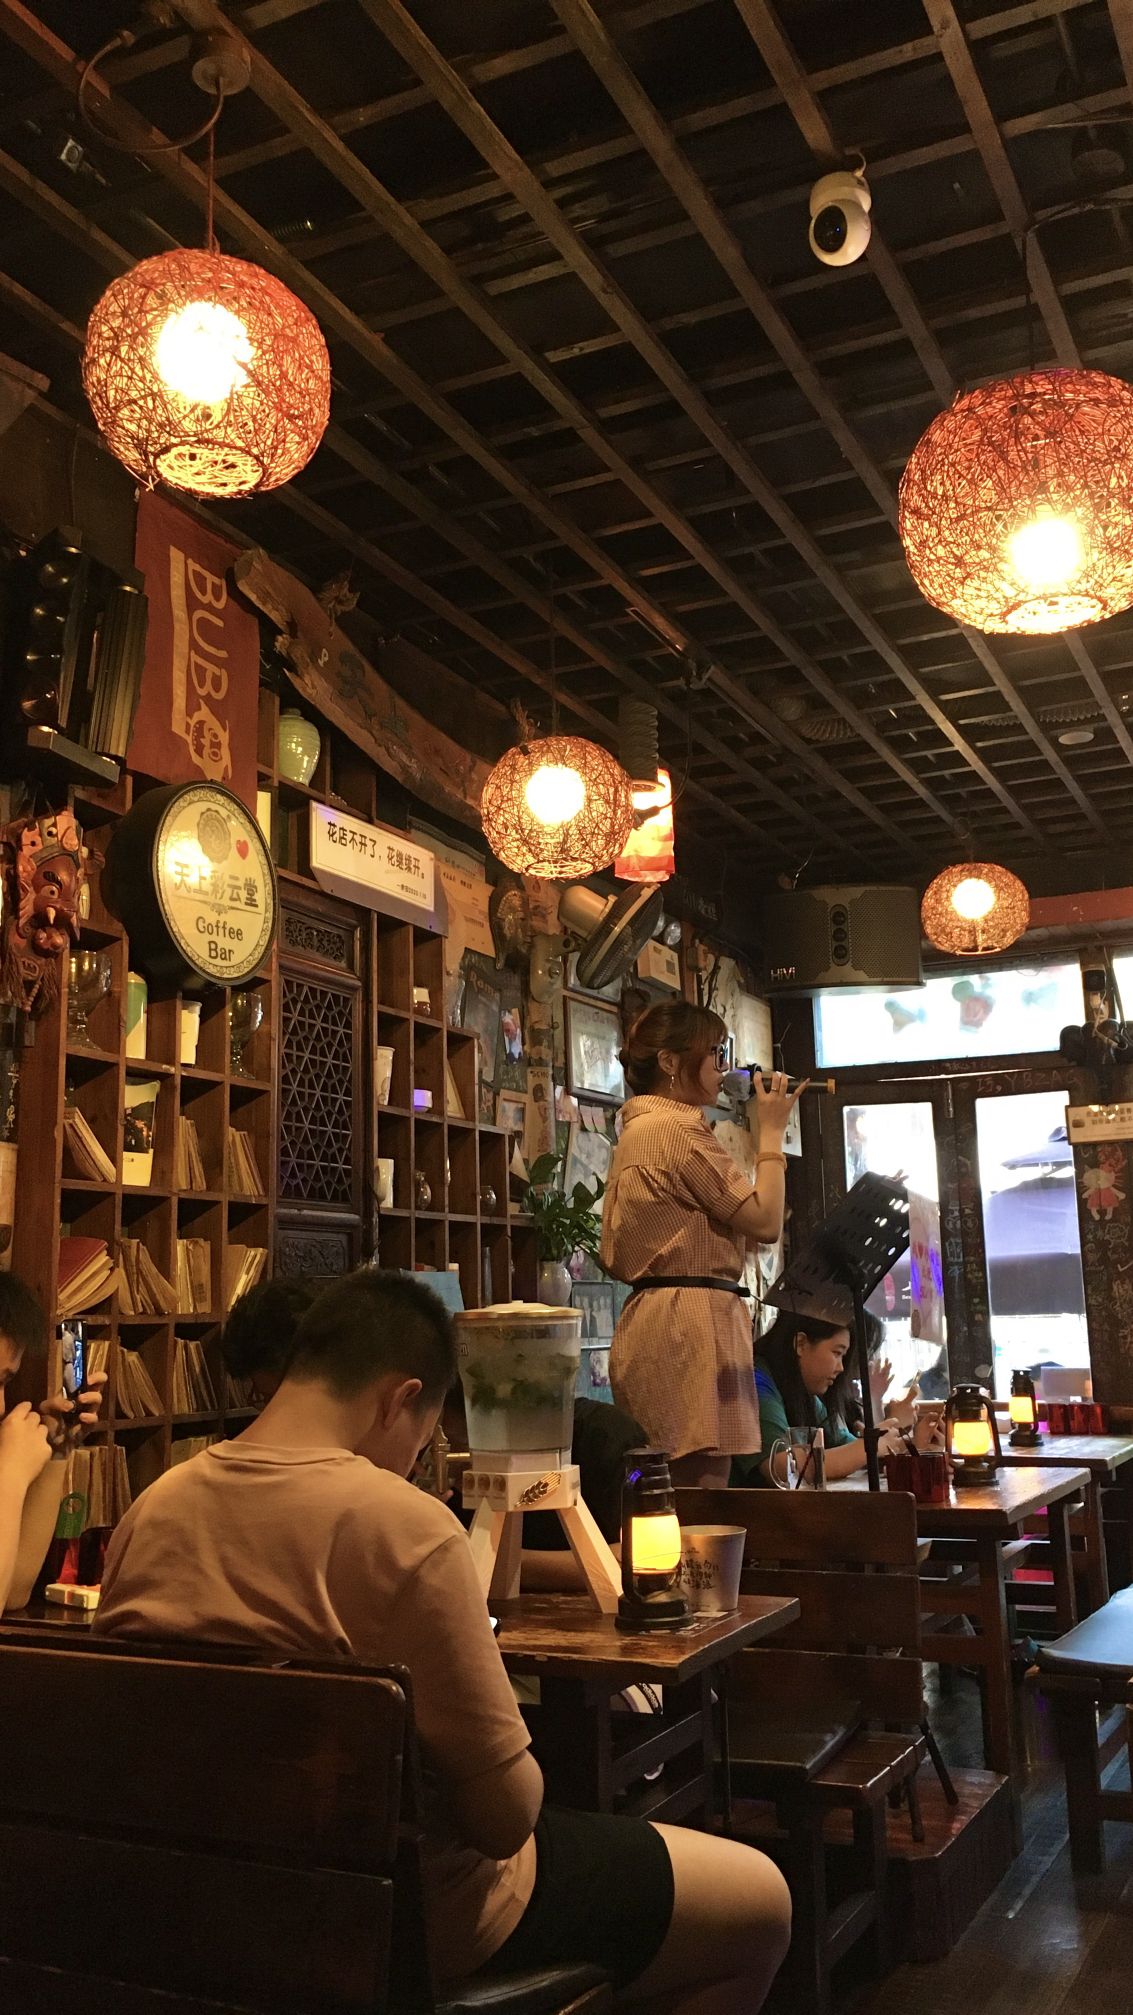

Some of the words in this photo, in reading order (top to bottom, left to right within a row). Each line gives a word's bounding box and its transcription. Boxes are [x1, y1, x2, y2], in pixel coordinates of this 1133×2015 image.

[174, 861, 259, 909] 天上彩云堂
[195, 915, 244, 942] Coffee
[208, 940, 235, 963] Bar
[770, 966, 796, 981] HiVi
